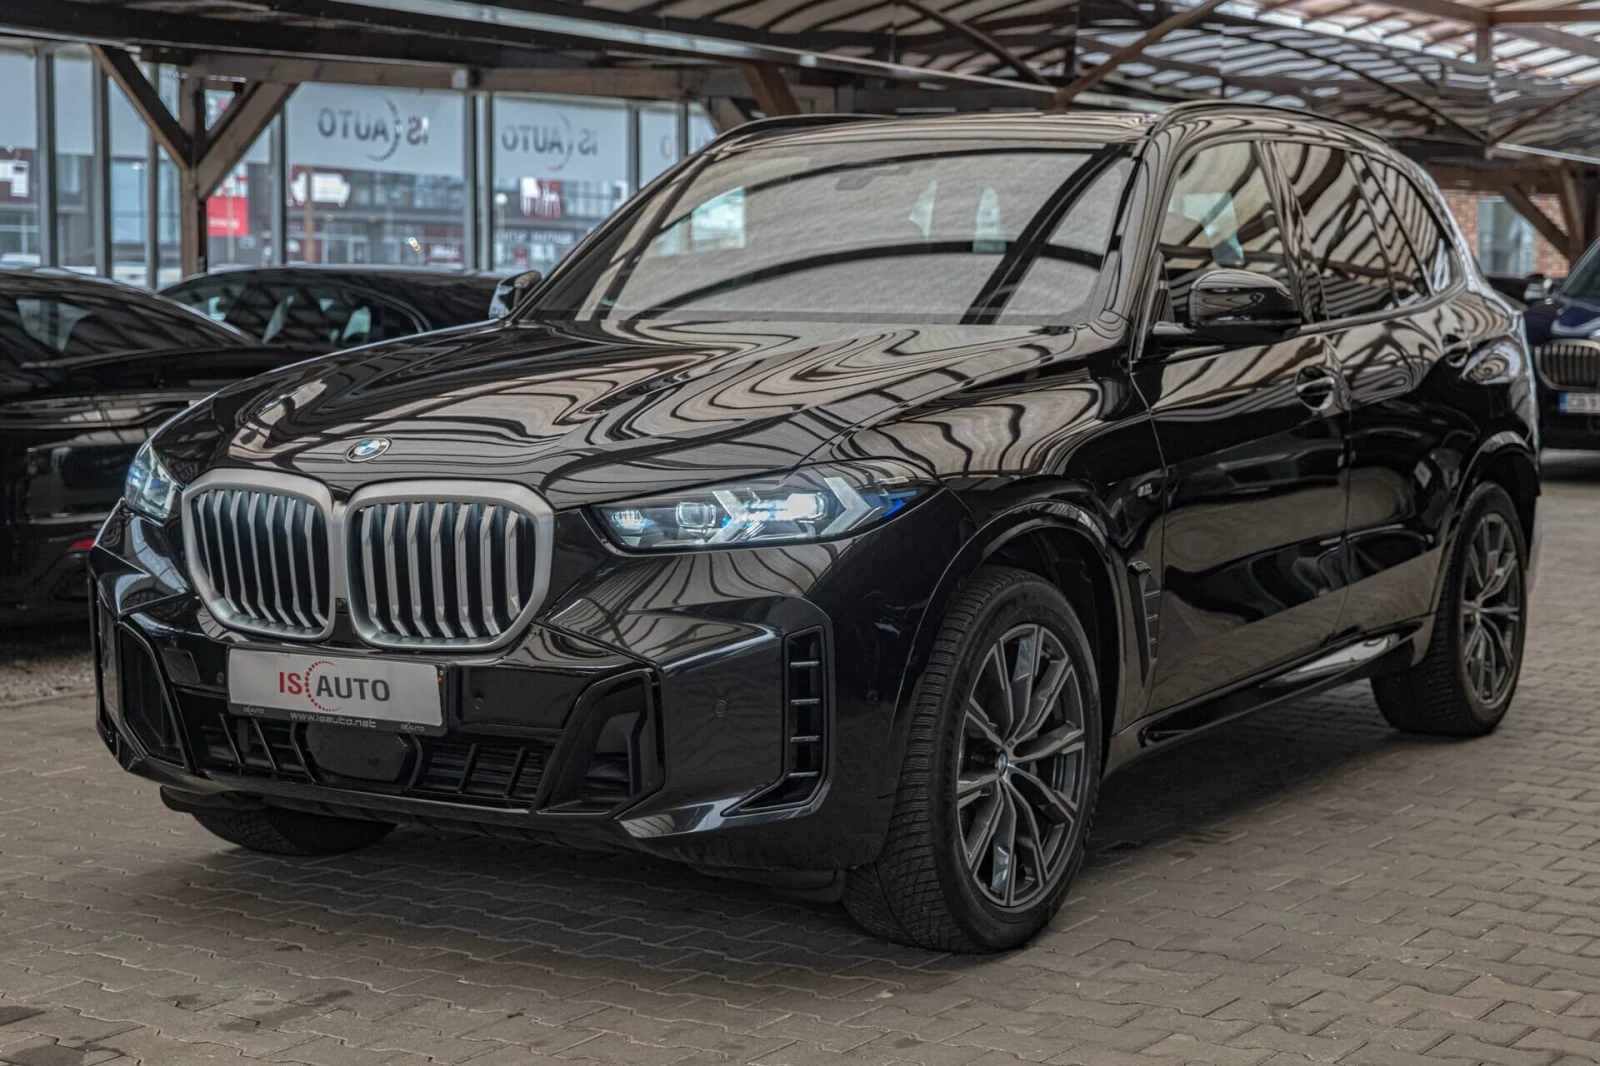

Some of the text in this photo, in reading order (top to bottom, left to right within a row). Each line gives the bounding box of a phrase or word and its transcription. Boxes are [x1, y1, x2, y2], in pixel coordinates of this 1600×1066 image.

[278, 671, 390, 702] IS AUTO
[289, 712, 377, 729] www.isauto.net
